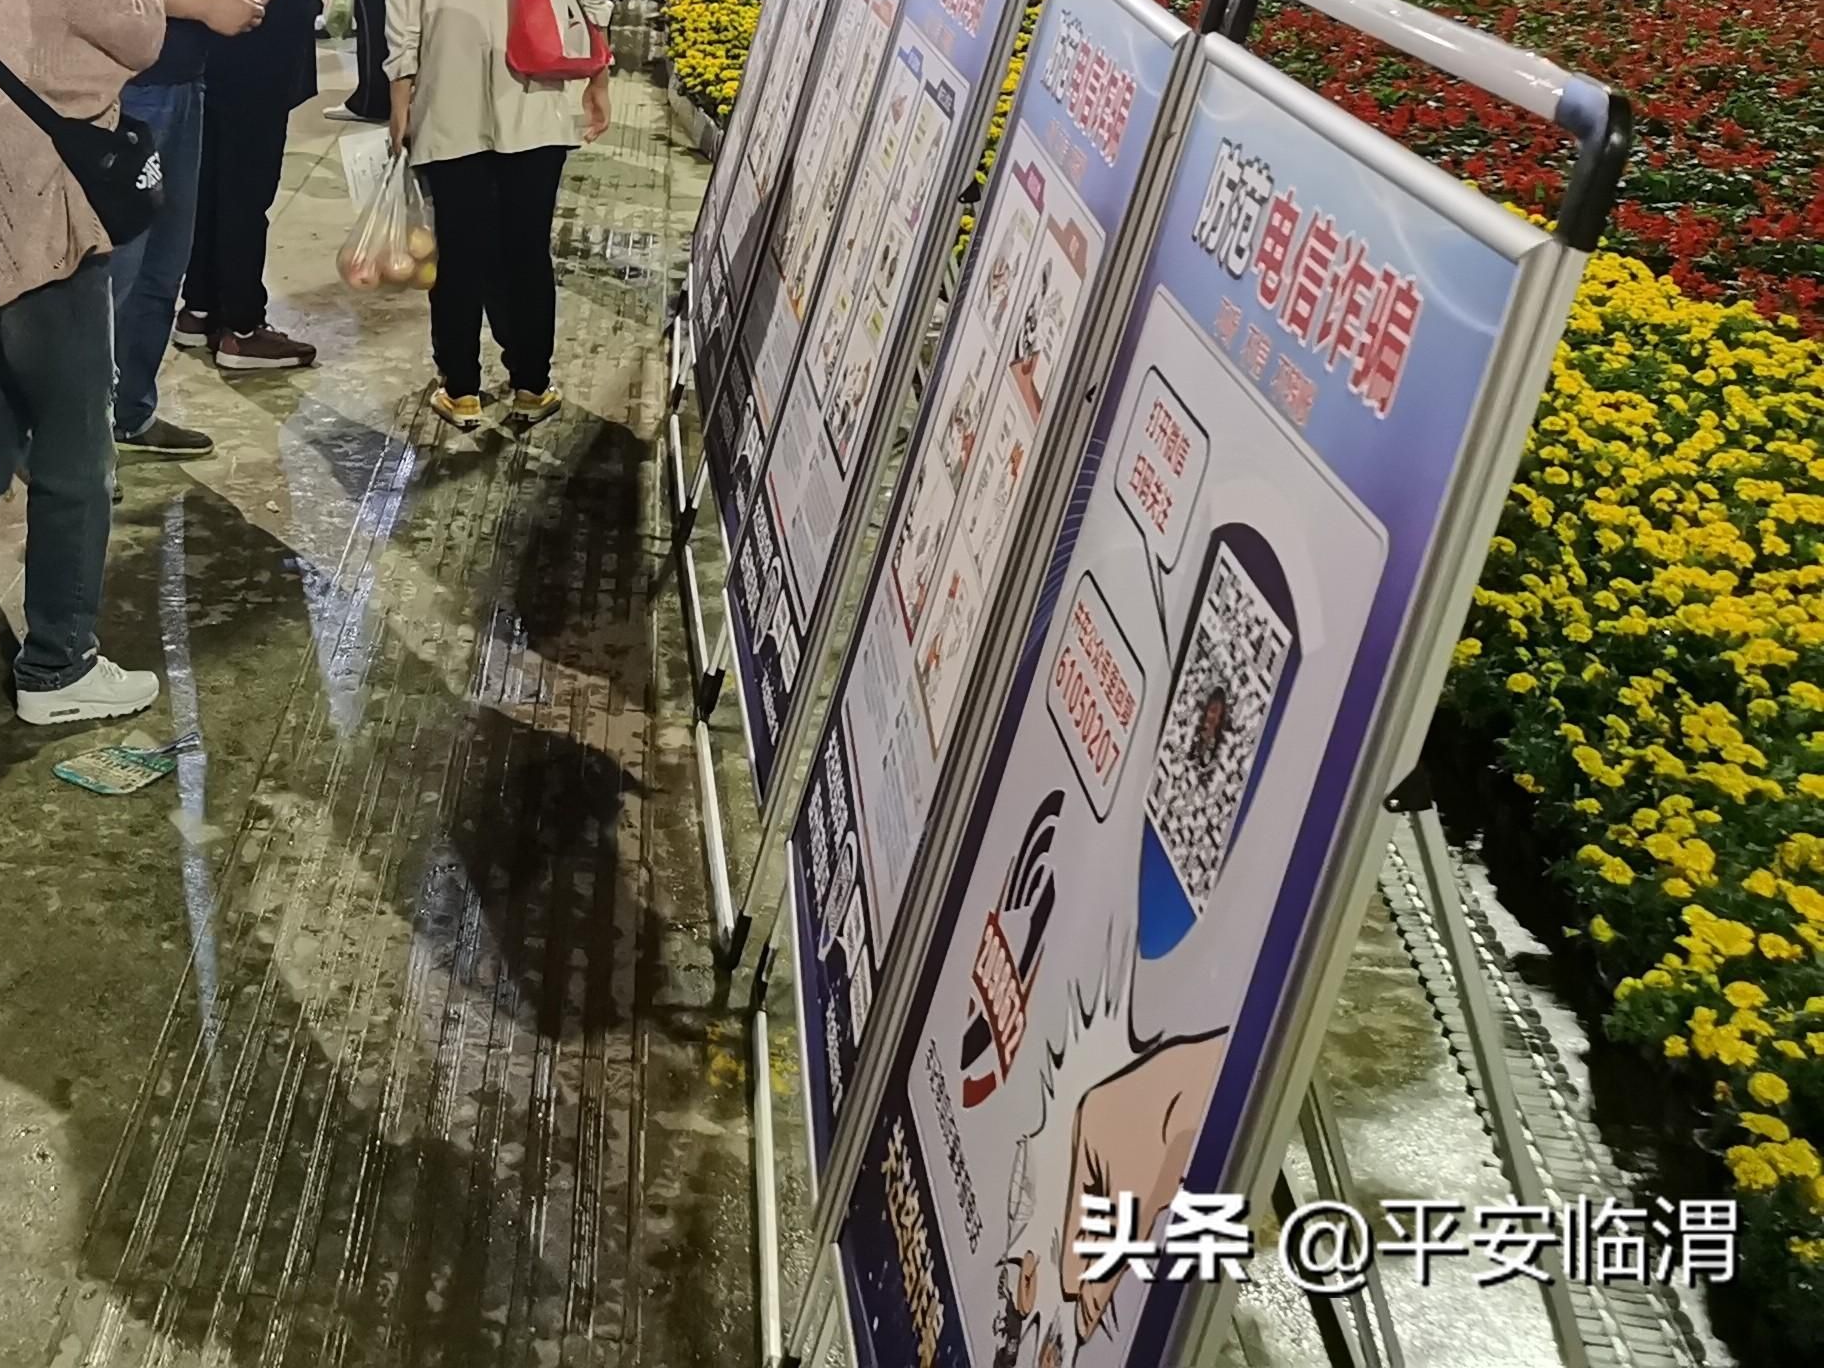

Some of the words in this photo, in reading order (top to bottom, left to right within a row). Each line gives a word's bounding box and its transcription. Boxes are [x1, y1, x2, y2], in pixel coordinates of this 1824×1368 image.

[1192, 136, 1424, 419] 防范电信诈骗
[1145, 396, 1191, 479] 打开微信
[1056, 646, 1120, 787] 61050207
